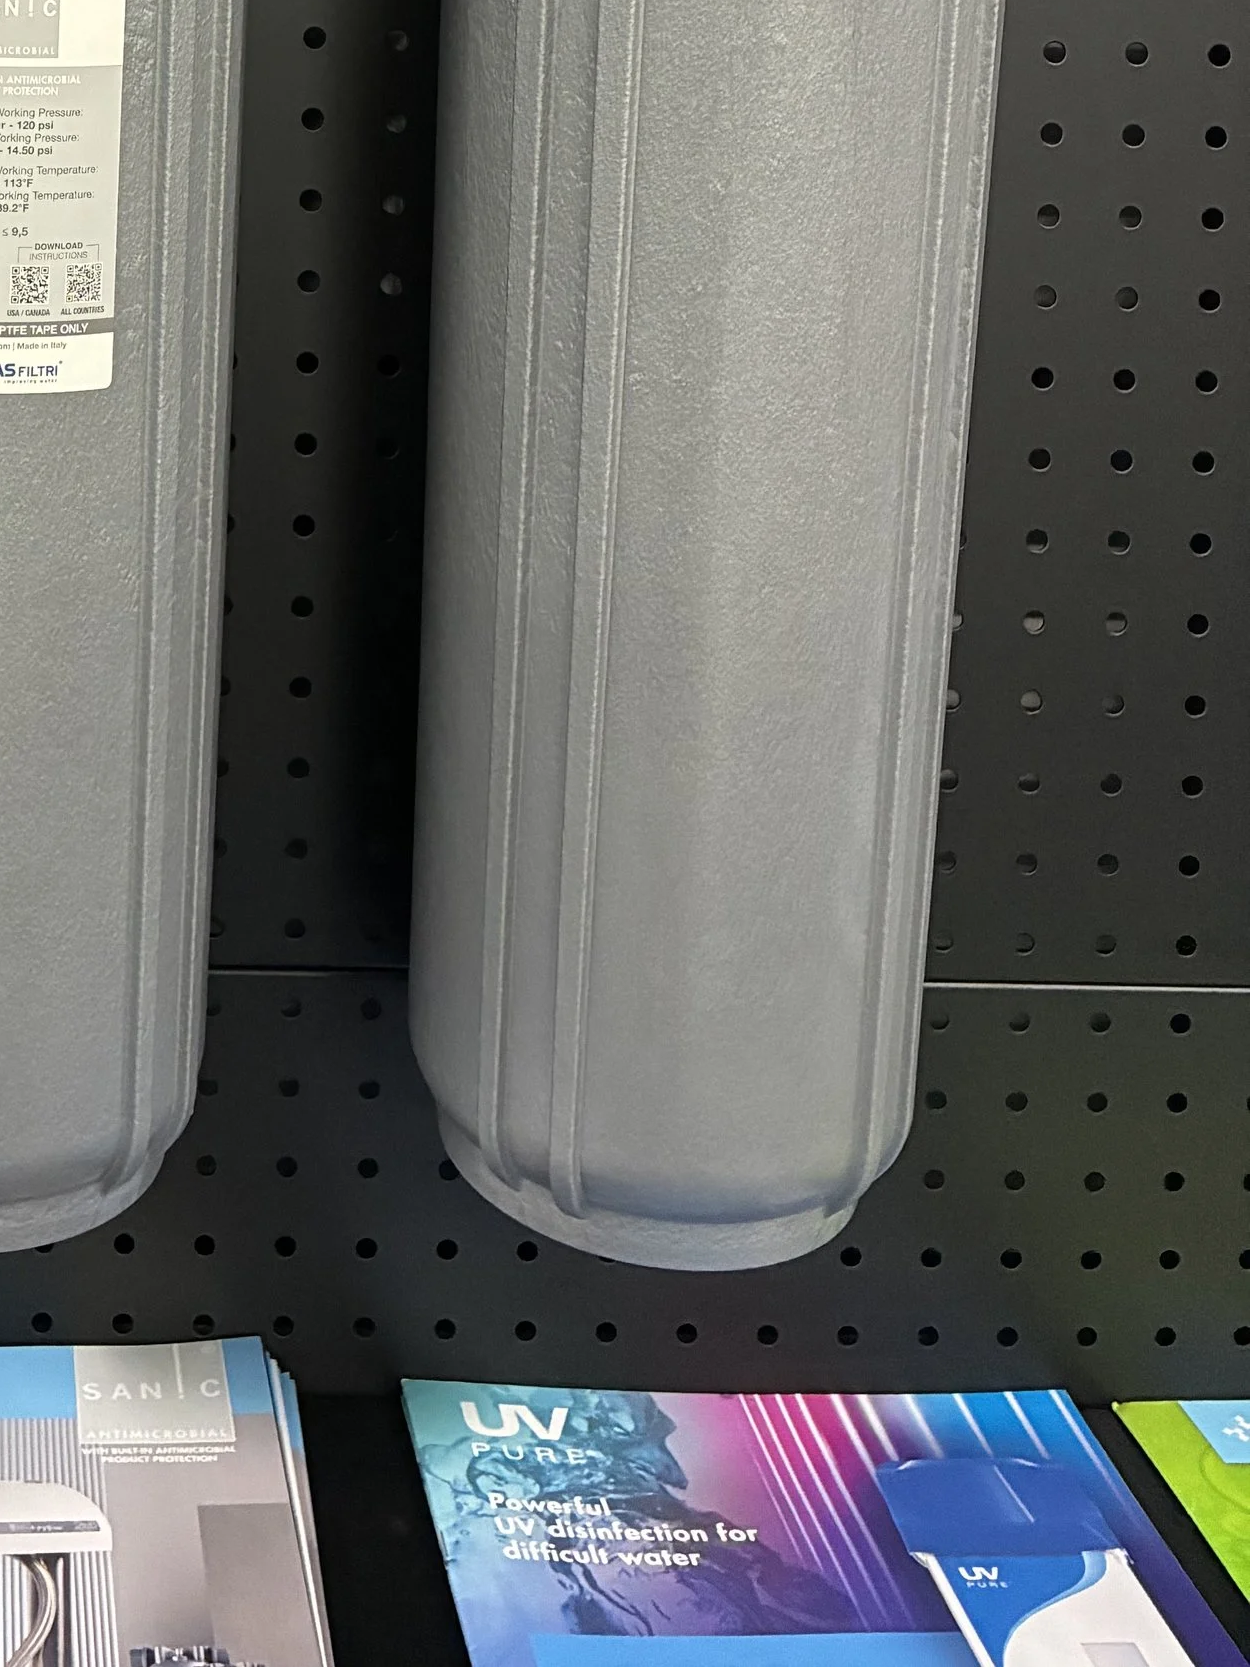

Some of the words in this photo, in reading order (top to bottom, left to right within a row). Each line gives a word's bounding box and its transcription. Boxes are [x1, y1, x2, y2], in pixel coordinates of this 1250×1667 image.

[6, 75, 81, 84] ANTIMICROBIAL
[3, 86, 58, 96] PROTECTION
[38, 108, 83, 117] Pressure:
[17, 121, 35, 130] 120
[38, 121, 54, 131] psi
[34, 134, 79, 142] Pressure:
[7, 146, 34, 155] 14.50
[37, 147, 53, 156] psi
[36, 166, 98, 176] Temperature:
[32, 191, 94, 200] Temperature:
[34, 242, 83, 250] DOWNLOAD
[29, 251, 87, 260] INSTRUCTIONS
[30, 324, 57, 335] TAPE
[60, 323, 88, 334] ONLY
[51, 341, 67, 350] Italy
[18, 366, 57, 377] FILTRI
[460, 1400, 569, 1441] UV
[87, 1429, 228, 1439] ANTIMICROBIAL
[471, 1441, 586, 1465] PURE
[488, 1493, 612, 1517] Powerful
[494, 1517, 536, 1537] UV
[547, 1520, 710, 1544] disinfection
[717, 1523, 759, 1543] for
[503, 1542, 608, 1566] difficult
[620, 1549, 702, 1568] water
